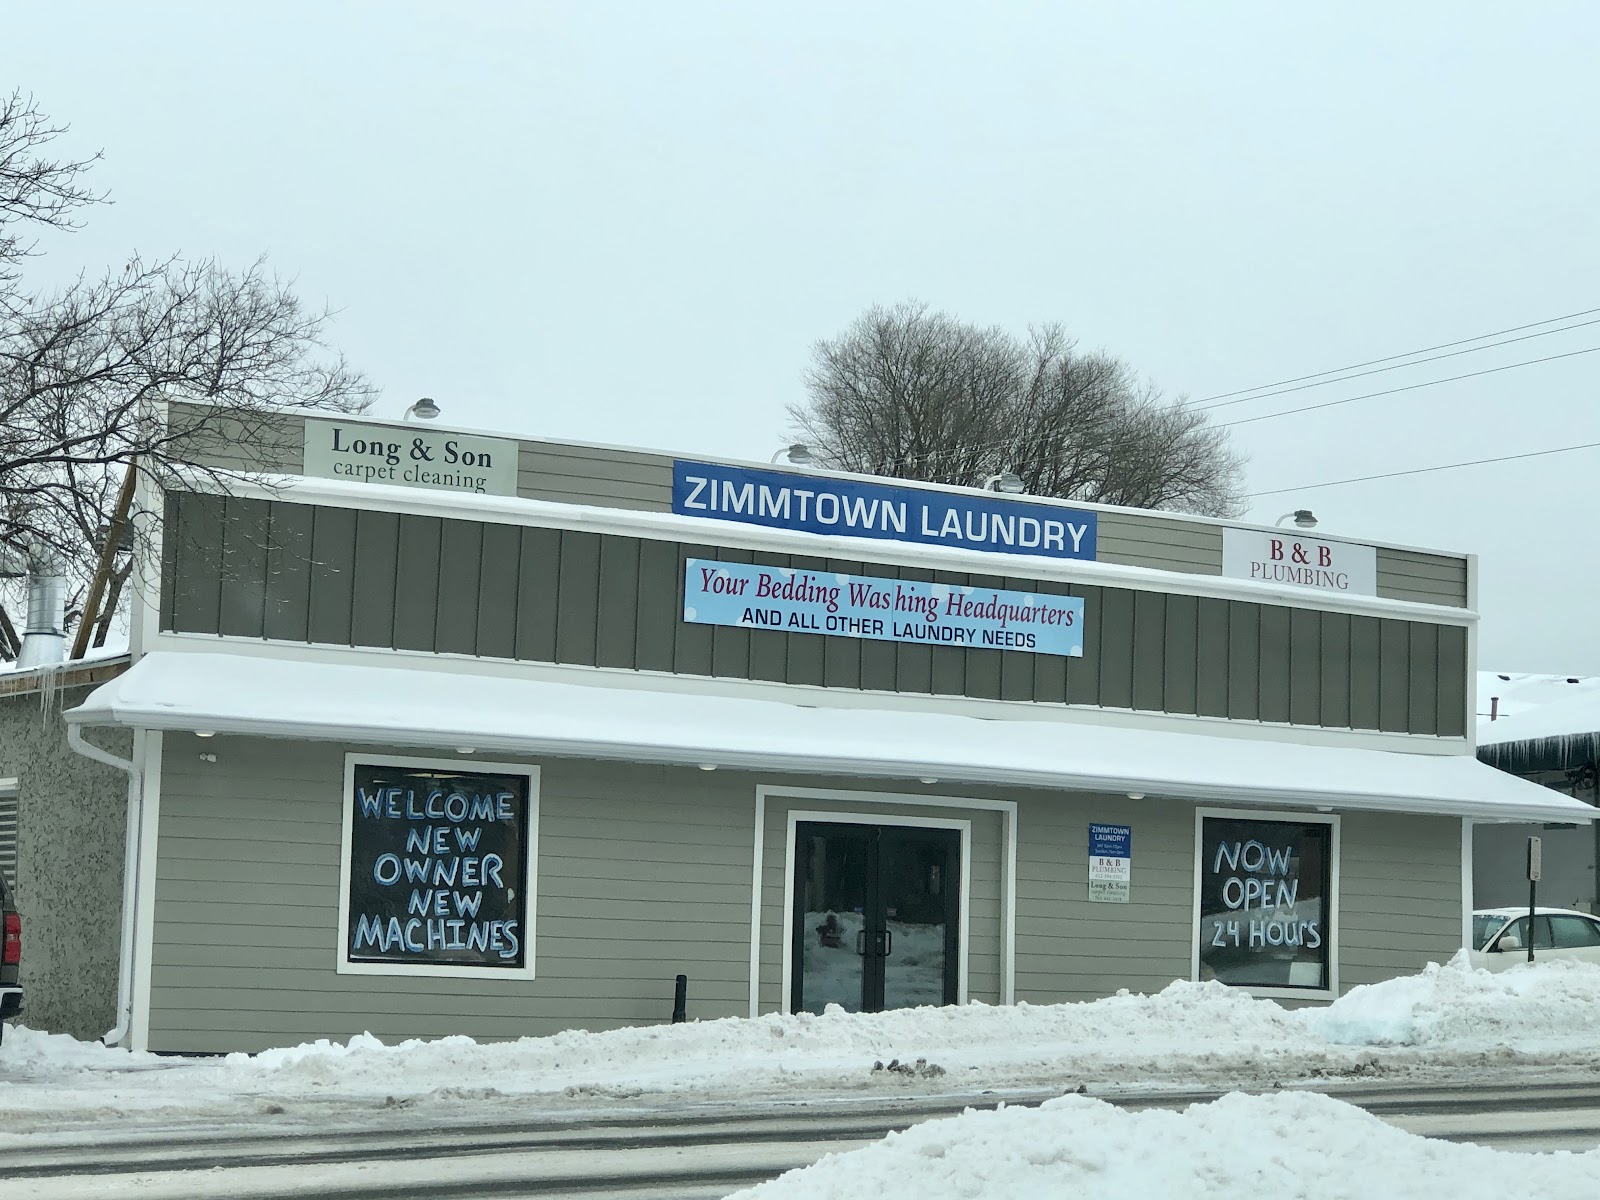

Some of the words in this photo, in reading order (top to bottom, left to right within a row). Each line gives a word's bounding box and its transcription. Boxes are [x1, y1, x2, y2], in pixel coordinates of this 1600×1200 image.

[332, 428, 402, 466] Long
[410, 437, 435, 462] &
[444, 440, 493, 468] Son
[333, 461, 396, 483] carpet
[403, 465, 487, 494] cleaning
[684, 475, 907, 533] ZIMMTOWN
[921, 505, 1088, 553] LAUNDRY
[1270, 539, 1284, 561] B
[1291, 542, 1311, 565] &
[1317, 545, 1332, 567] B
[1250, 561, 1349, 590] PLUMBING
[701, 567, 749, 596] Your
[755, 573, 840, 613] Bedding
[848, 582, 939, 622] Washing
[945, 592, 1074, 628] Headquarters
[742, 607, 782, 626] AND
[788, 612, 820, 630] ALL
[826, 615, 884, 635] OTHER
[893, 621, 976, 643] LAUNDRY
[982, 629, 1036, 648] NEEDS
[357, 787, 515, 823] WELCOME
[406, 825, 482, 855] NEW
[1091, 825, 1129, 835] ZIMMTOWN
[1094, 833, 1126, 842] LAUNDRY
[373, 853, 504, 888] OWNER
[1091, 866, 1127, 874] PLUMBING
[1099, 858, 1104, 866] B
[1106, 858, 1113, 867] &
[1115, 859, 1121, 867] B
[1213, 839, 1293, 876] NOW
[1091, 881, 1107, 891] Long
[1107, 882, 1114, 890] &
[1222, 876, 1299, 911] OPEN
[408, 888, 482, 919] NEW
[353, 913, 519, 958] MACHINES
[1211, 920, 1240, 948] 24
